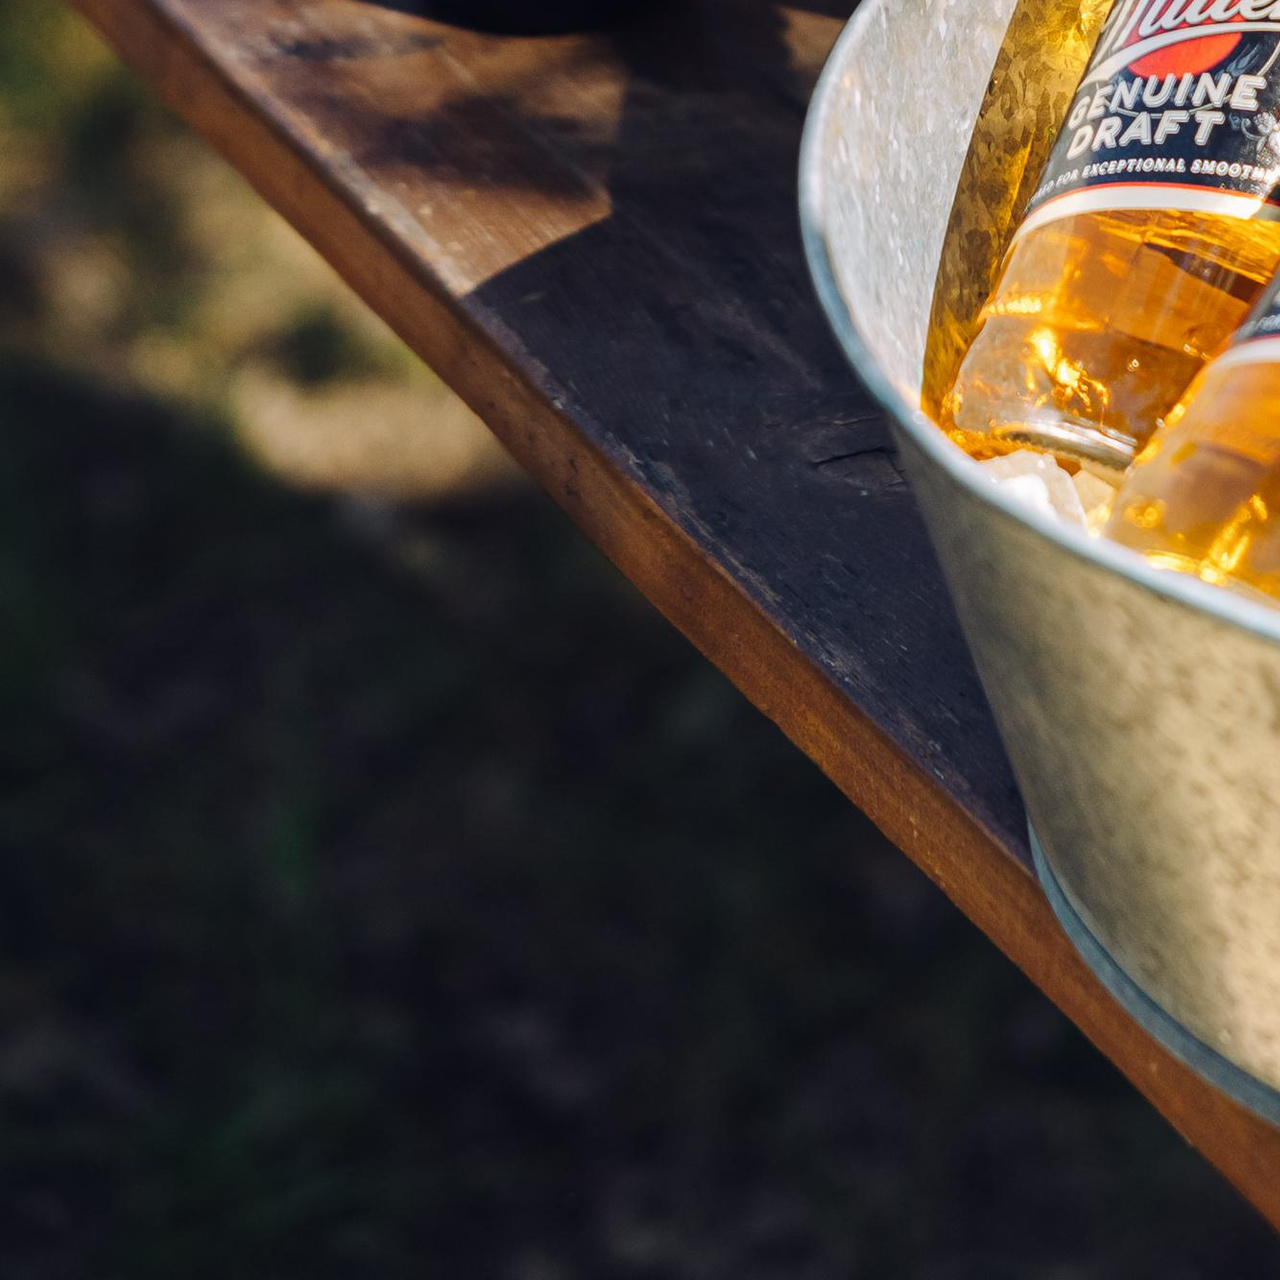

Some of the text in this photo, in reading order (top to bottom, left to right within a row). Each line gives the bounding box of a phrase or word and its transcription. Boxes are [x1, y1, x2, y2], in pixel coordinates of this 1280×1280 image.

[1068, 73, 1267, 130] GENUINE
[1066, 110, 1225, 160] DRAFT
[1082, 158, 1185, 179] EXCEPTIONAL
